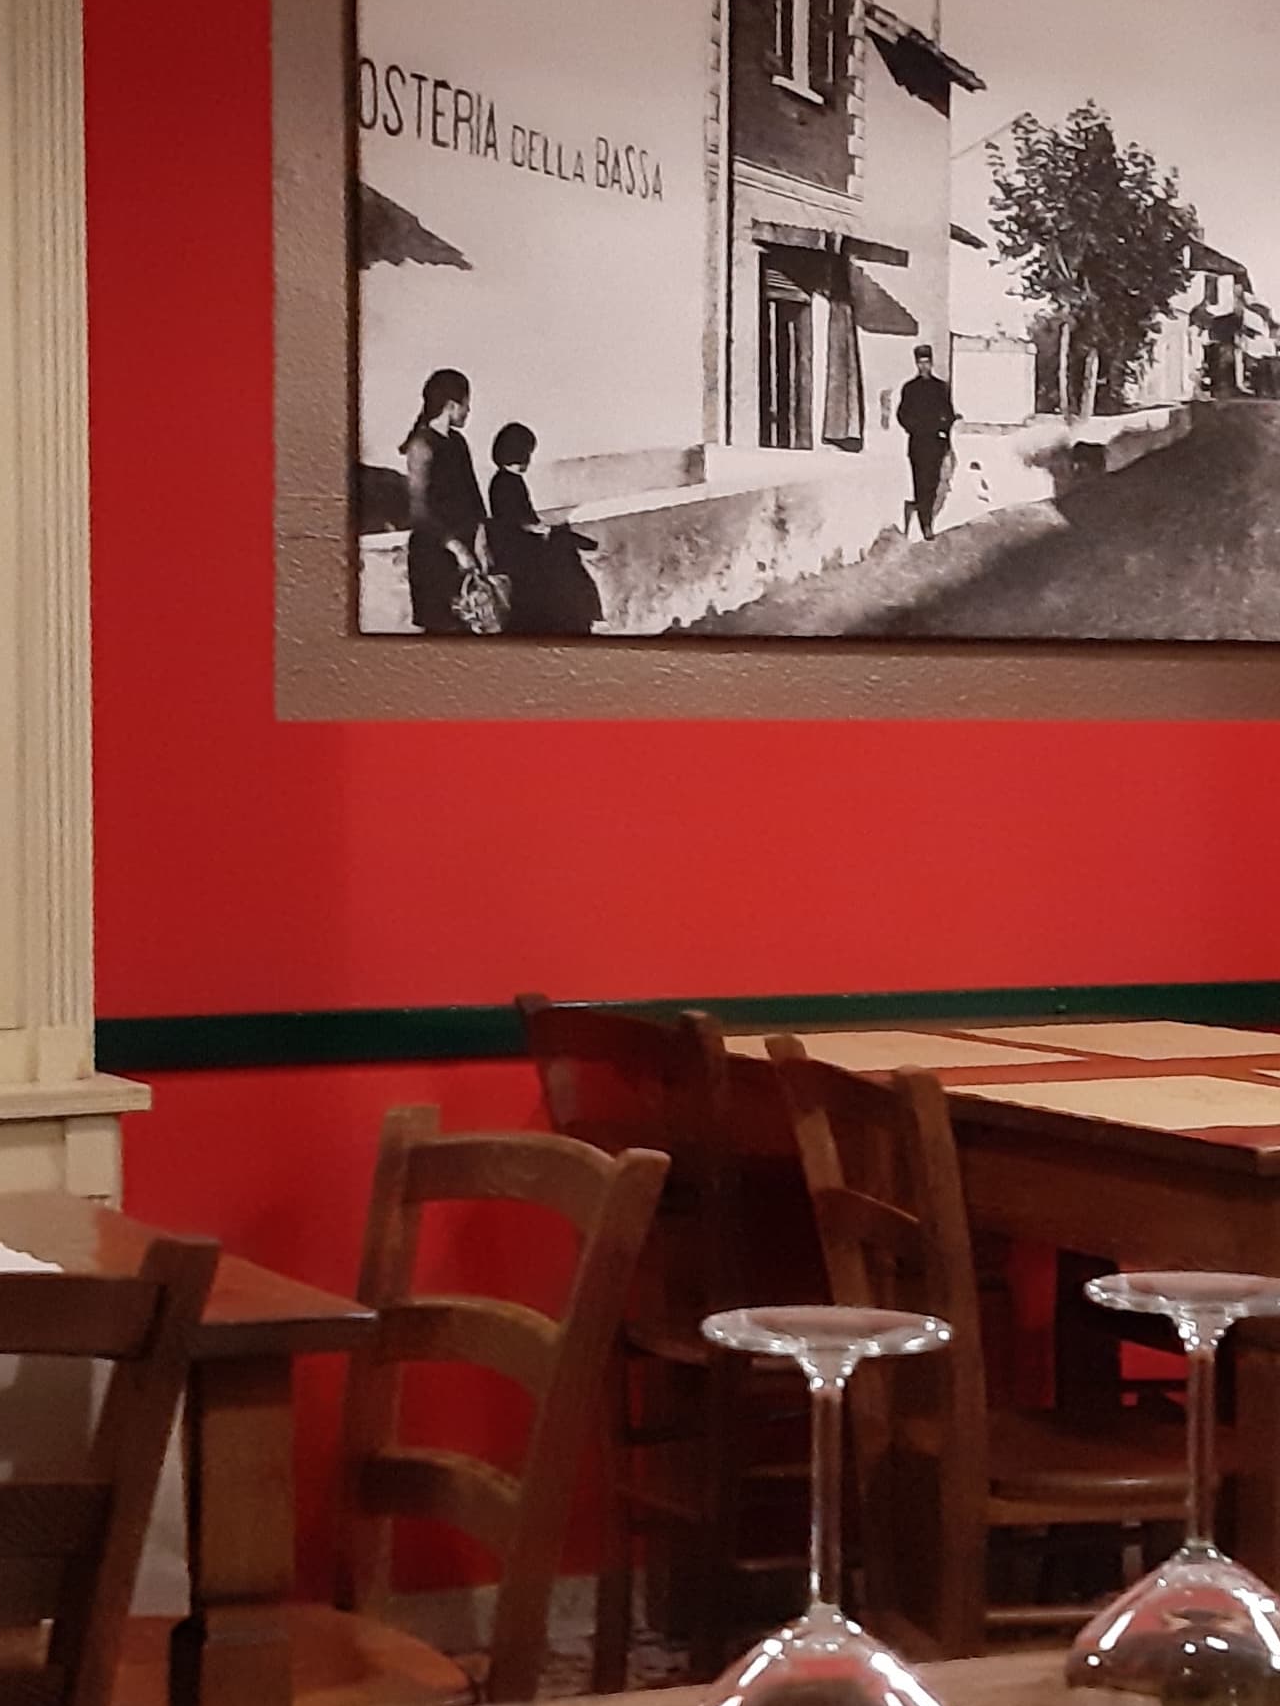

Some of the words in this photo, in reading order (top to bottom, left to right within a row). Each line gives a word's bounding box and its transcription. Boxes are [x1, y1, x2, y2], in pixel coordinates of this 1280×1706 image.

[358, 57, 499, 161] OSTERIA
[511, 124, 585, 184] DELLA
[595, 137, 664, 201] BASSA
